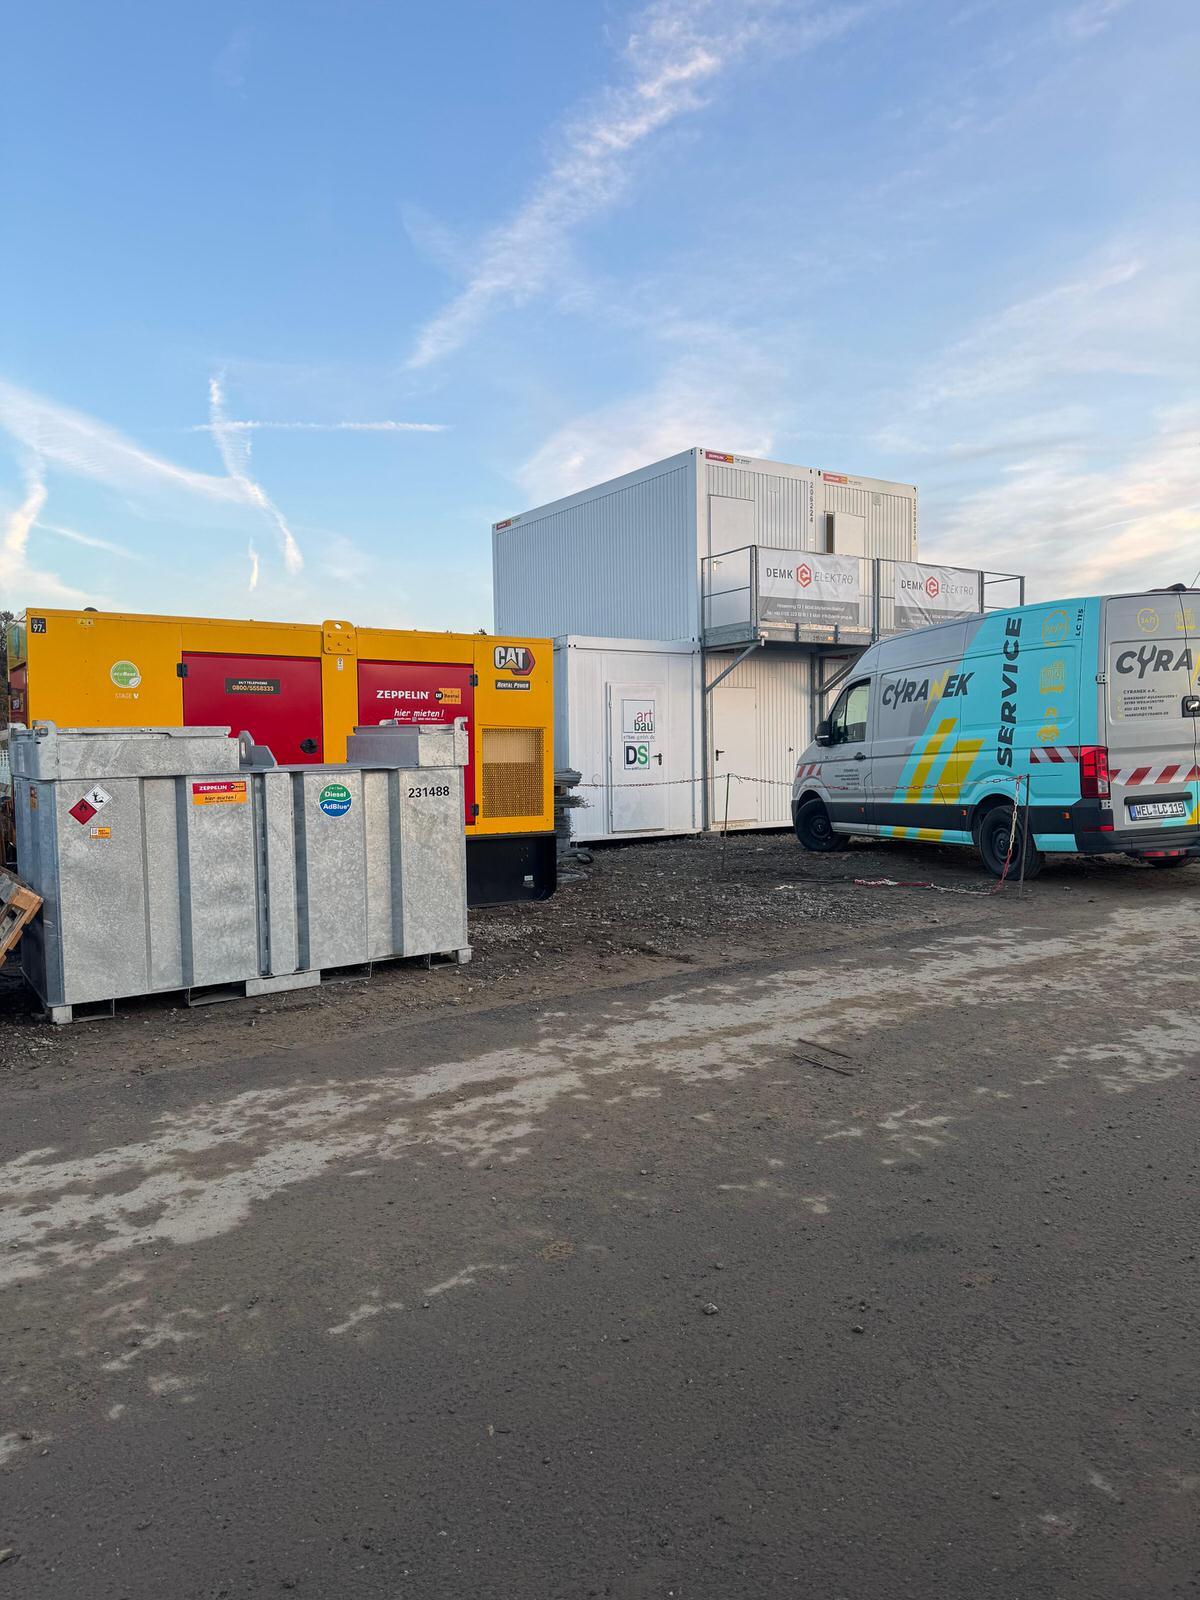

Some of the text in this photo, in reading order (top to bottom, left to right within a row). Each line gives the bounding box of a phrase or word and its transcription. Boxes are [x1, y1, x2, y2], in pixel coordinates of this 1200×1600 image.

[814, 571, 854, 585] ELEKTRO
[940, 583, 974, 596] ELEKTRO
[495, 646, 526, 669] CAT
[376, 689, 430, 700] ZEPPELIN
[882, 670, 975, 711] CYRANEK
[997, 617, 1022, 768] SERVICE
[394, 708, 412, 717] hier
[636, 709, 654, 723] art
[633, 719, 654, 732] bau
[625, 745, 648, 765] DS
[324, 790, 346, 798] Diesel
[408, 786, 450, 798] 231488
[1135, 802, 1184, 817] WEL LC 115
